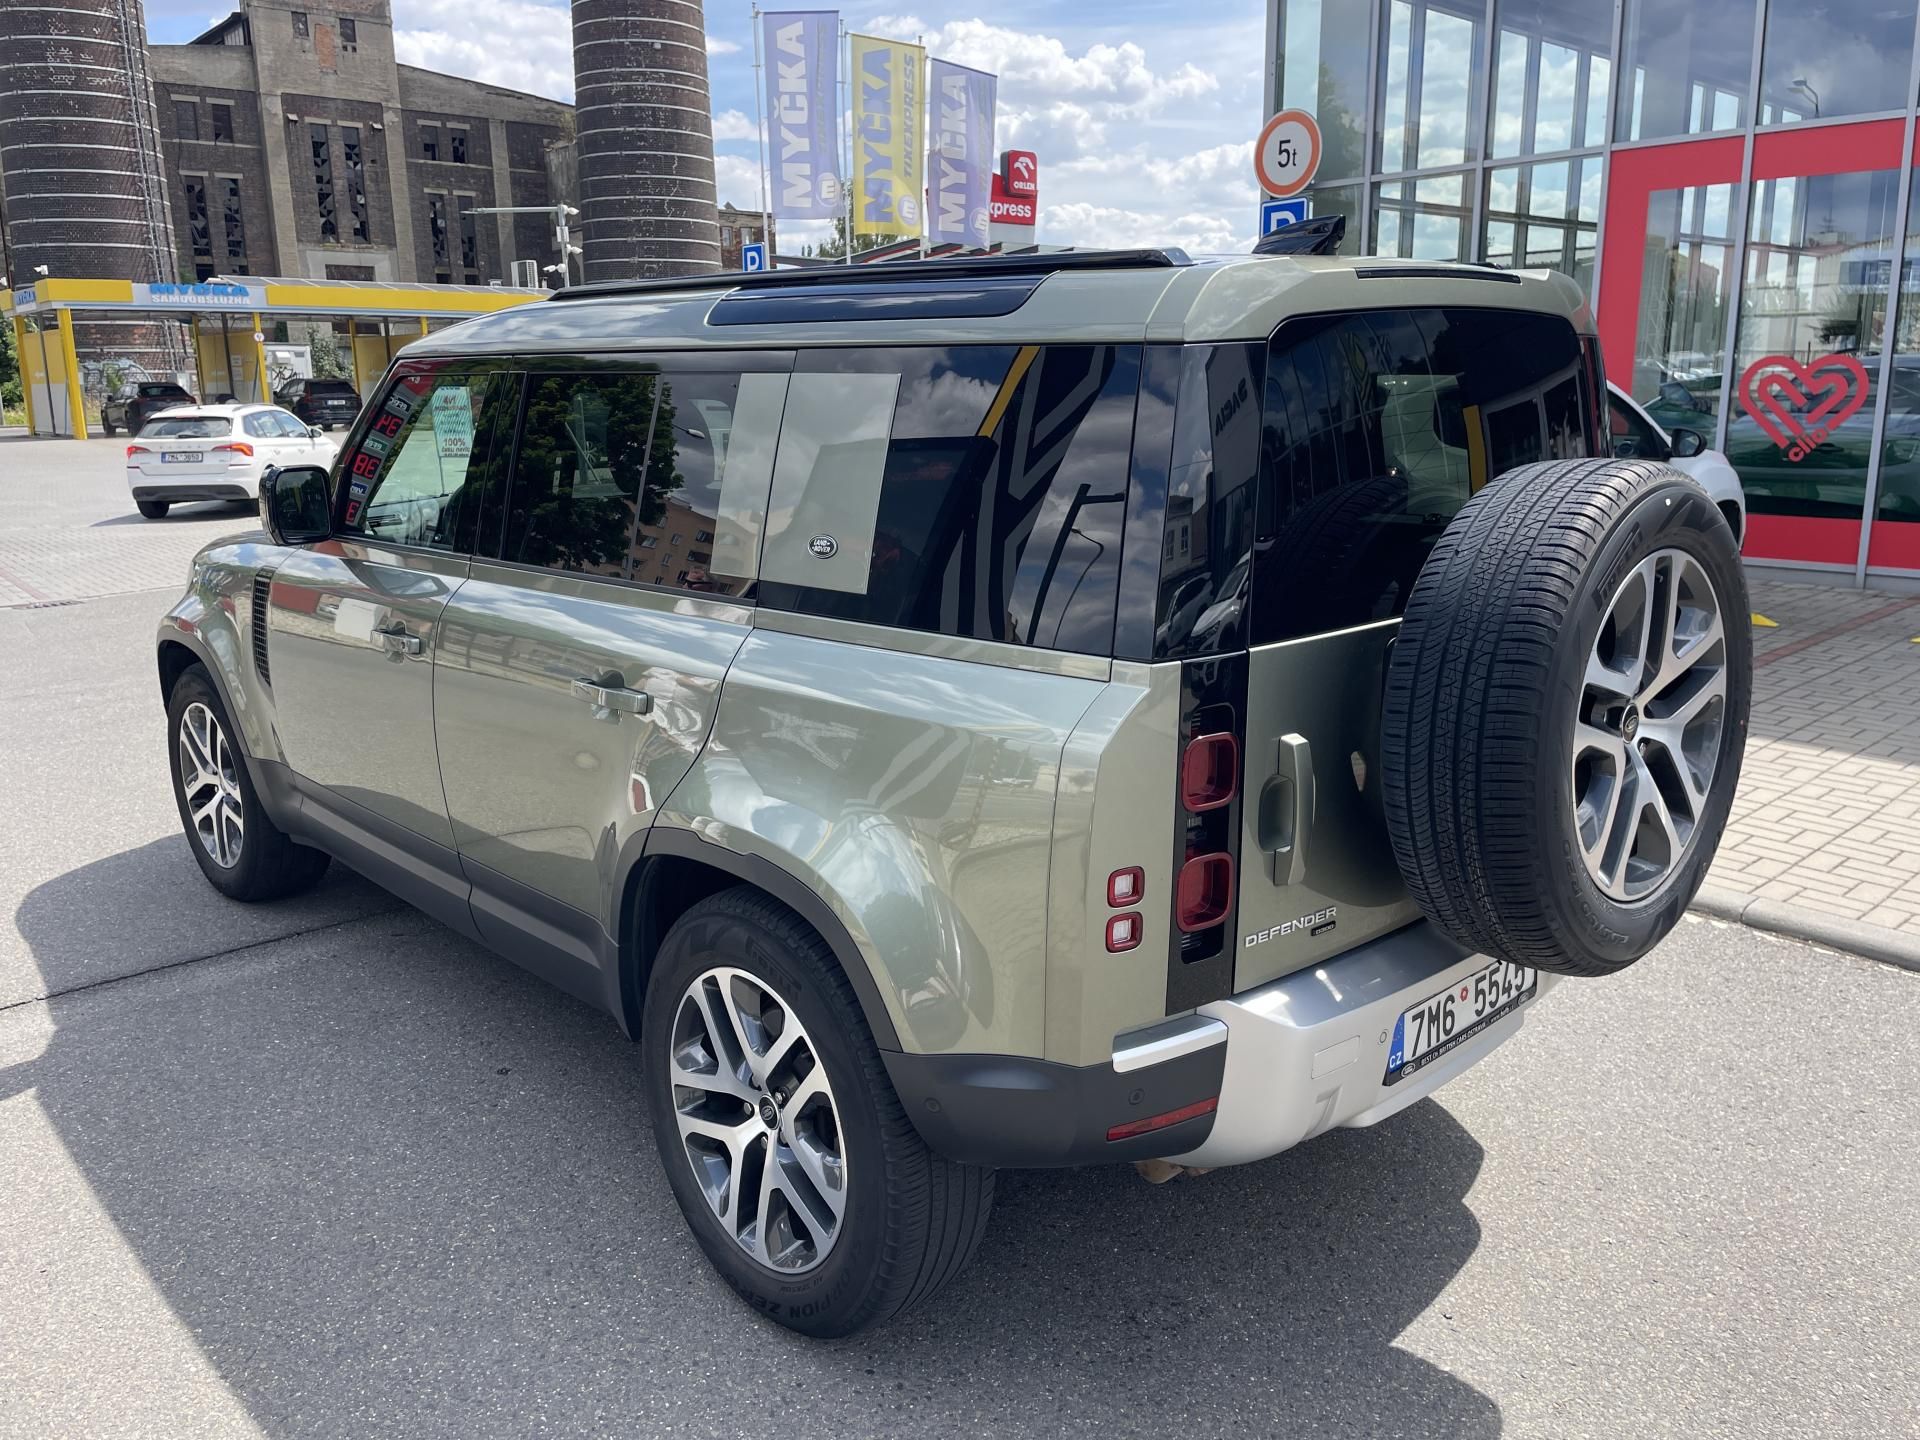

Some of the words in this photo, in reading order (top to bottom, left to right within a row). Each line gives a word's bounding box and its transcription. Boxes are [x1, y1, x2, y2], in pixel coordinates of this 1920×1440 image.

[774, 20, 812, 208] MYČKA
[858, 48, 894, 223] MYČKA
[935, 74, 967, 233] MYČKA
[1277, 139, 1298, 168] 5t
[1013, 180, 1036, 190] ORLEN
[746, 251, 760, 272] P
[1788, 428, 1828, 462] clio
[1245, 906, 1338, 948] DEFENDER
[1412, 993, 1456, 1058] 7M6
[1474, 961, 1526, 1018] 5545
[1389, 1051, 1403, 1069] CZ
